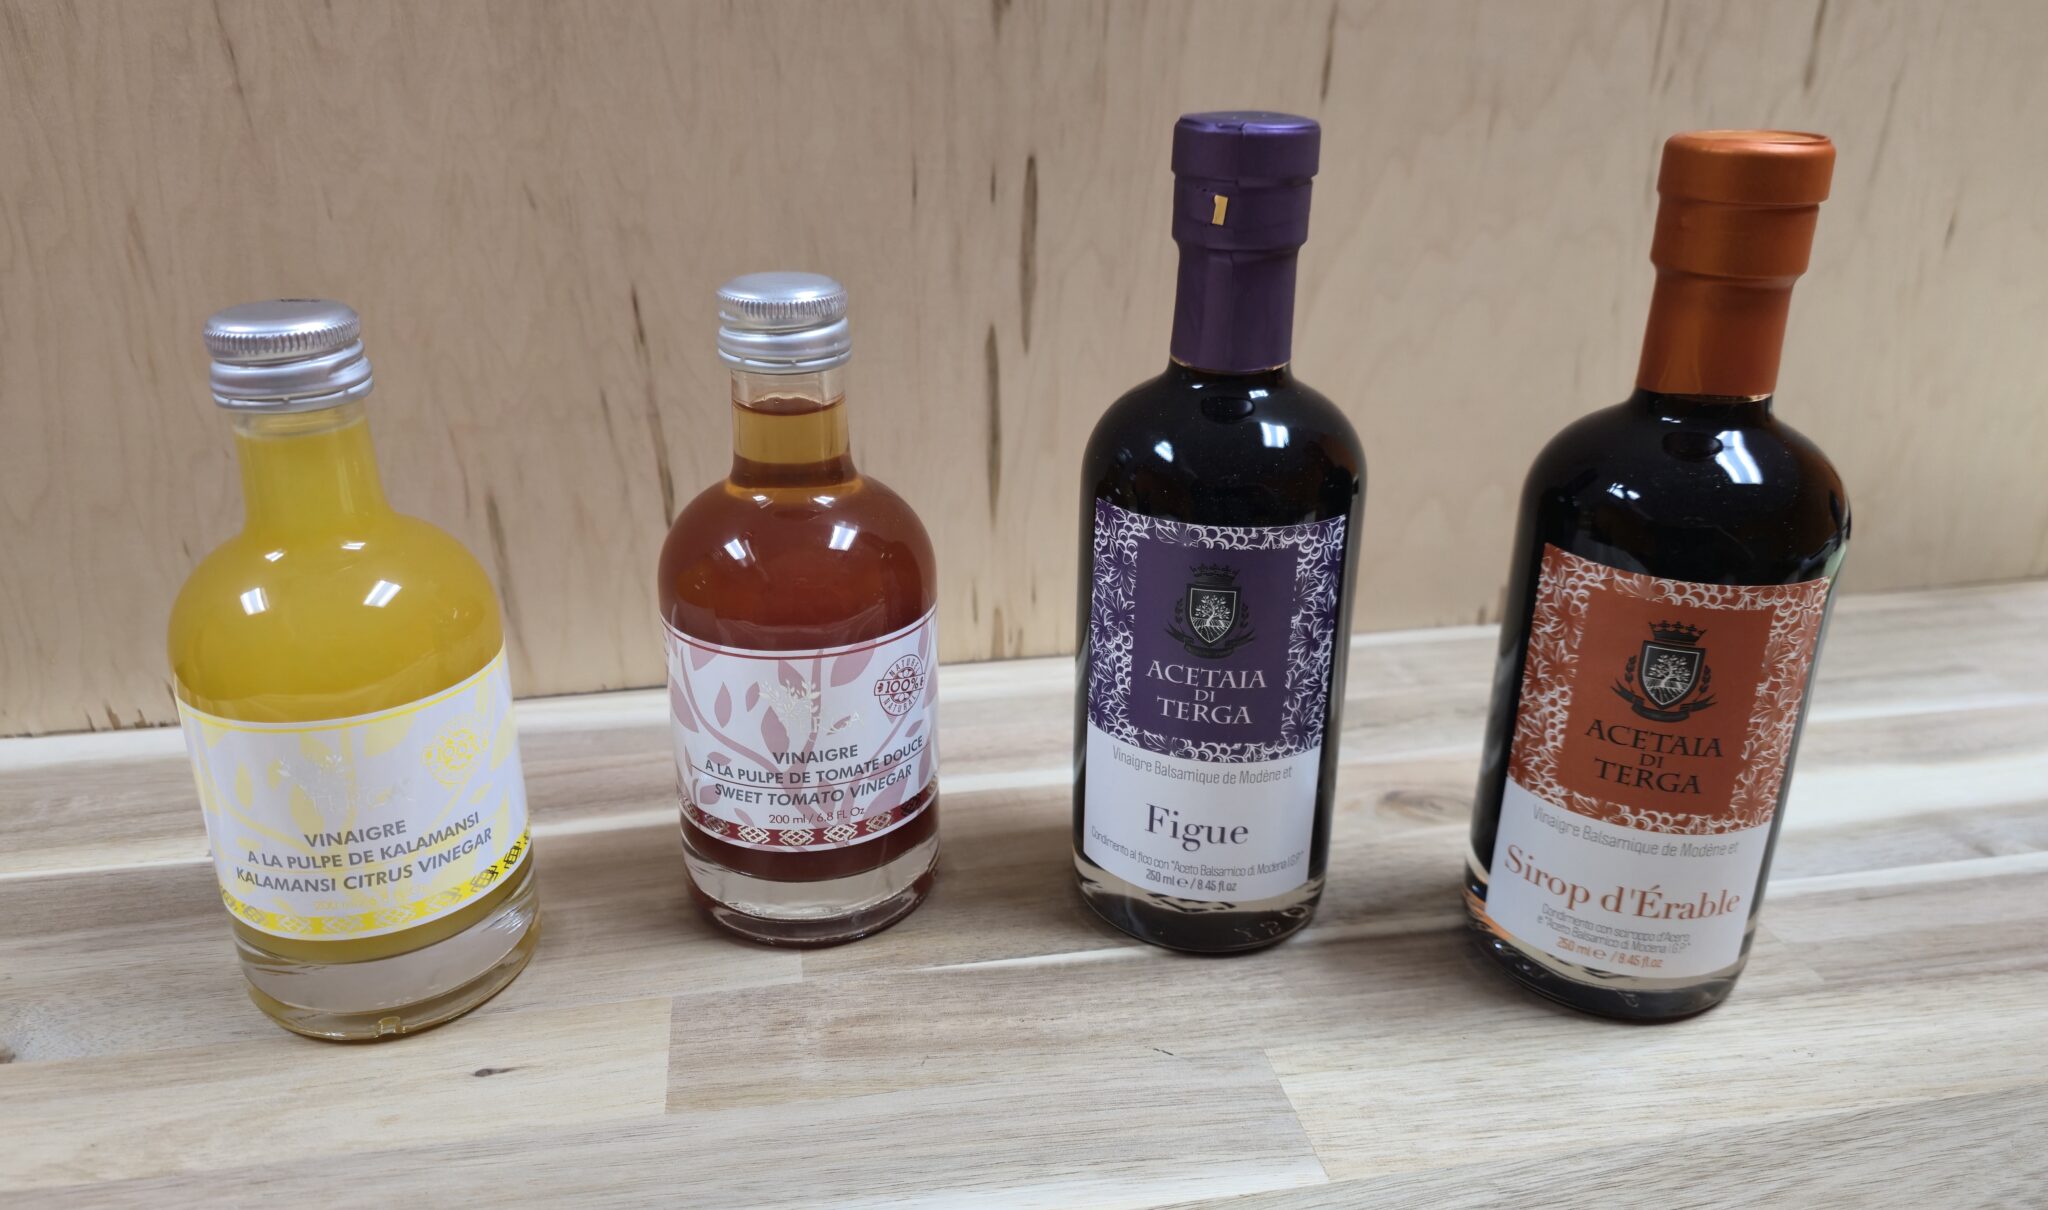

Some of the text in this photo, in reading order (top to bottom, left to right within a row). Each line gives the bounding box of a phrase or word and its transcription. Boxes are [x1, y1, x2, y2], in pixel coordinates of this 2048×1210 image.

[889, 658, 922, 679] NATUREL
[1145, 659, 1268, 689] ACETAIA
[886, 678, 919, 694] 100%
[1195, 689, 1215, 702] DI
[882, 694, 917, 714] NATURAL
[1157, 696, 1253, 725] TERGA
[1584, 719, 1723, 757] ACETAIA
[705, 735, 924, 784] A LA PULPE DE TOMATE DOUCE
[773, 745, 858, 765] VINAIGRE
[1112, 745, 1293, 785] Vinaigre Balsamique de Modène et
[1639, 753, 1664, 768] DI
[715, 764, 912, 806] SWEET TOMATO VINEGAR
[1594, 757, 1702, 794] TERGA
[769, 814, 790, 824] 200
[793, 813, 806, 824] ml
[816, 812, 834, 823] 6.8
[837, 810, 848, 819] FL
[850, 806, 865, 816] Oz
[1144, 803, 1249, 852] Figue
[248, 811, 480, 869] A LA PULPE DE KALAMANSI
[304, 820, 407, 848] VINAIGRE
[1532, 804, 1739, 857] Vinaigre Balsamique de Modène et
[236, 827, 492, 893] KALAMANSI CITRUS VINEGAR
[1091, 825, 1129, 857] Condimento
[1130, 849, 1137, 859] al
[1137, 851, 1153, 866] fico
[1153, 856, 1169, 870] con
[1200, 864, 1247, 877] Balsamico
[1247, 865, 1255, 876] di
[1256, 860, 1286, 874] Modena
[1146, 869, 1161, 882] 250
[1162, 873, 1175, 886] ml
[1504, 844, 1740, 920] Sirop d'Érable
[1542, 903, 1594, 931] Condimento
[1595, 923, 1613, 936] con
[1556, 936, 1575, 952] 250
[1577, 944, 1591, 956] ml
[1572, 927, 1619, 949] Balsamico
[1620, 939, 1630, 950] di
[1631, 941, 1667, 953] Modena
